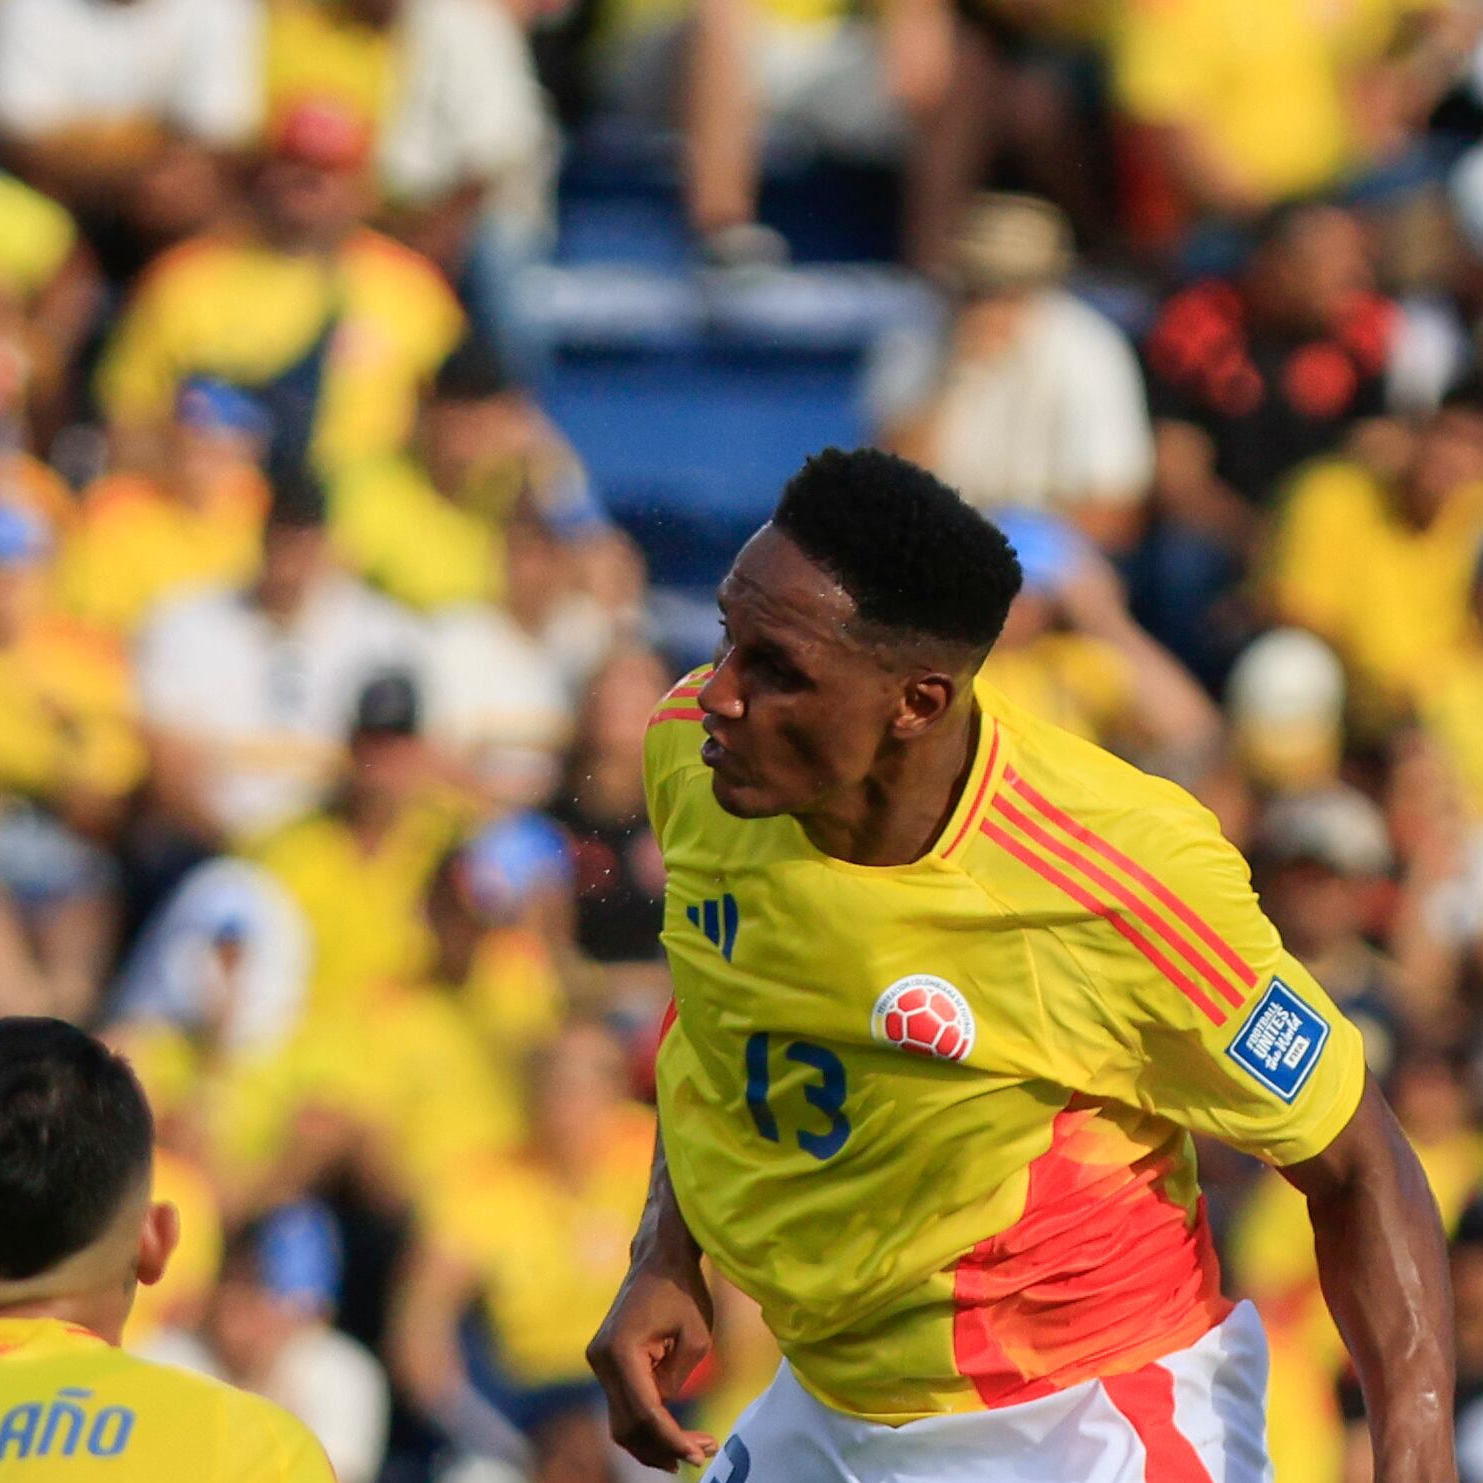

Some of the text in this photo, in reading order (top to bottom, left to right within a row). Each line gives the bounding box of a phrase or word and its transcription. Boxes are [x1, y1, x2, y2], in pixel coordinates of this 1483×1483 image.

[1246, 1002, 1283, 1048] FOOTBALL
[1253, 1009, 1289, 1059] UNITES
[1275, 1012, 1303, 1051] World
[1288, 1041, 1305, 1063] FIFA
[745, 1032, 852, 1160] 13
